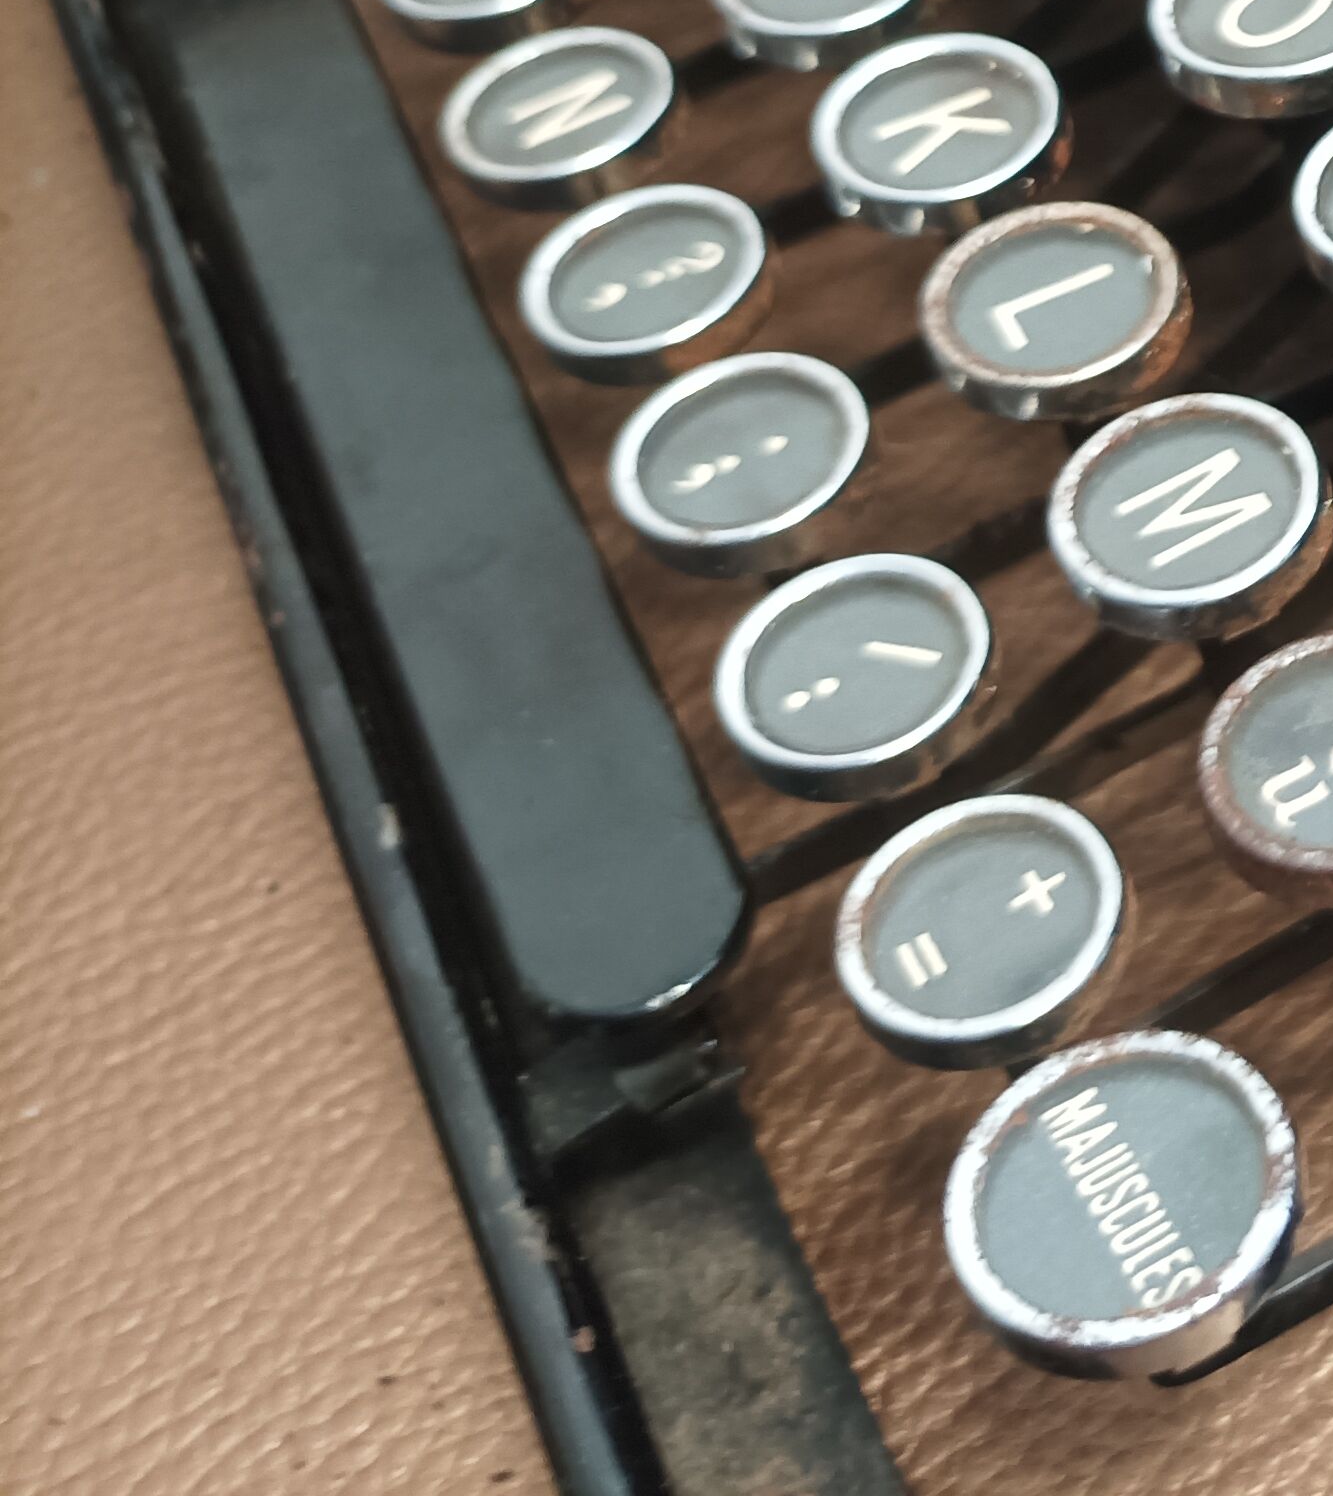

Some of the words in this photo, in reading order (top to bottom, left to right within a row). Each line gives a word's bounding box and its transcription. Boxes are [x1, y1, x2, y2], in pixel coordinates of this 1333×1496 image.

[508, 68, 633, 150] N
[872, 87, 1013, 176] K
[991, 262, 1113, 351] L
[1114, 448, 1272, 570] M
[1039, 1086, 1205, 1307] MAJUSCULES
